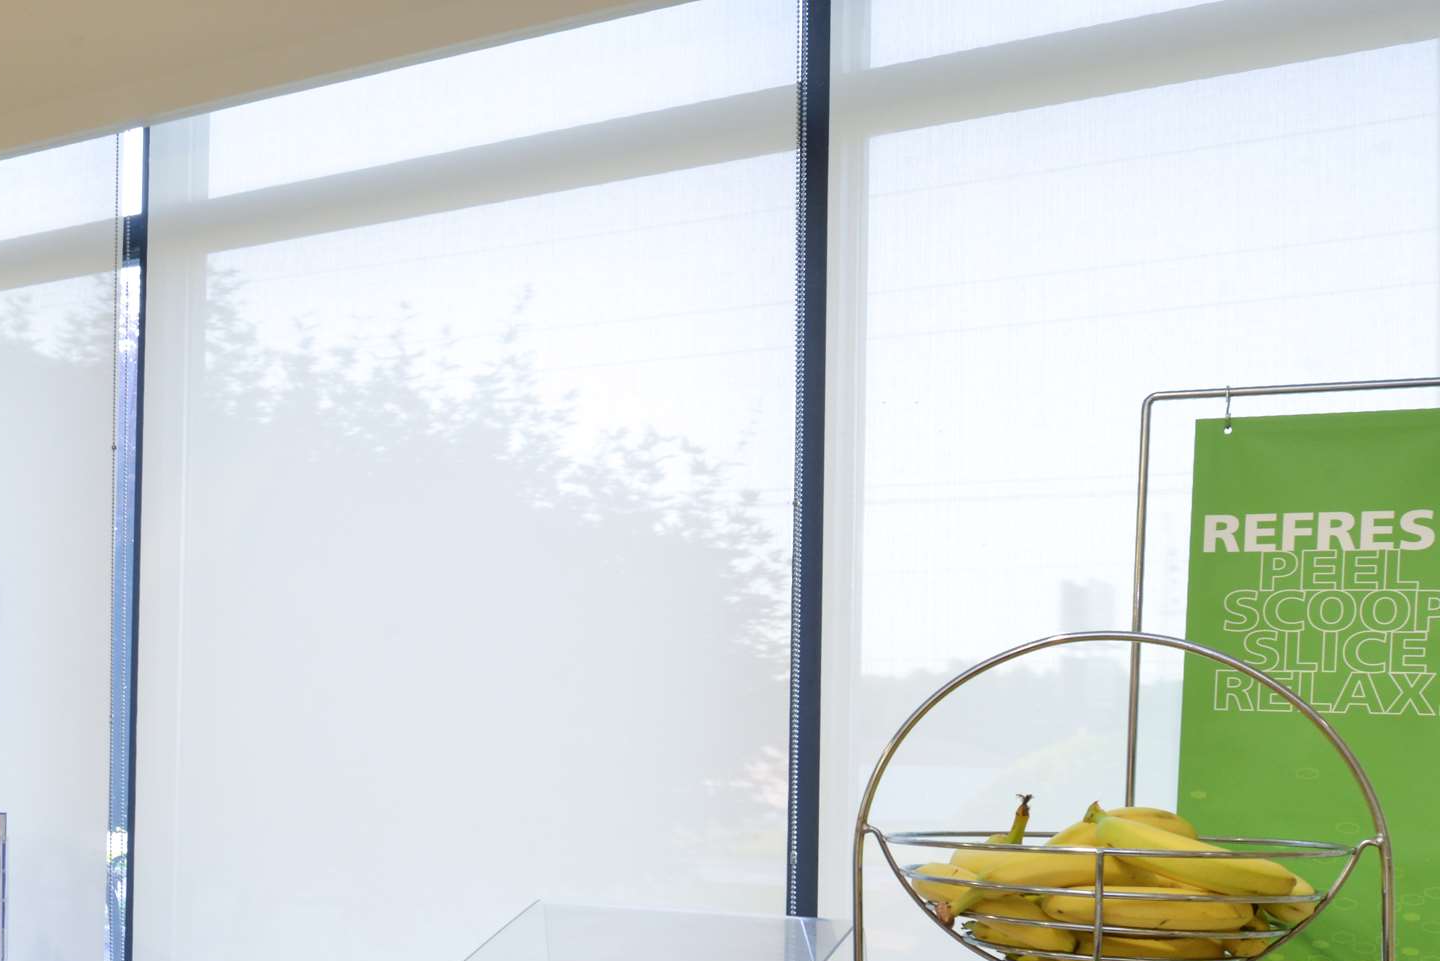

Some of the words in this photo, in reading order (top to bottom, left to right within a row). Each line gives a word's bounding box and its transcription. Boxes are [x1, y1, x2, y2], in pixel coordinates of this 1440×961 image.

[1203, 509, 1436, 553] REFRES
[1259, 549, 1420, 592] PEEL
[1223, 588, 1440, 633] SCOOP
[1242, 629, 1429, 673] SLICE
[1213, 668, 1440, 716] RELAX
